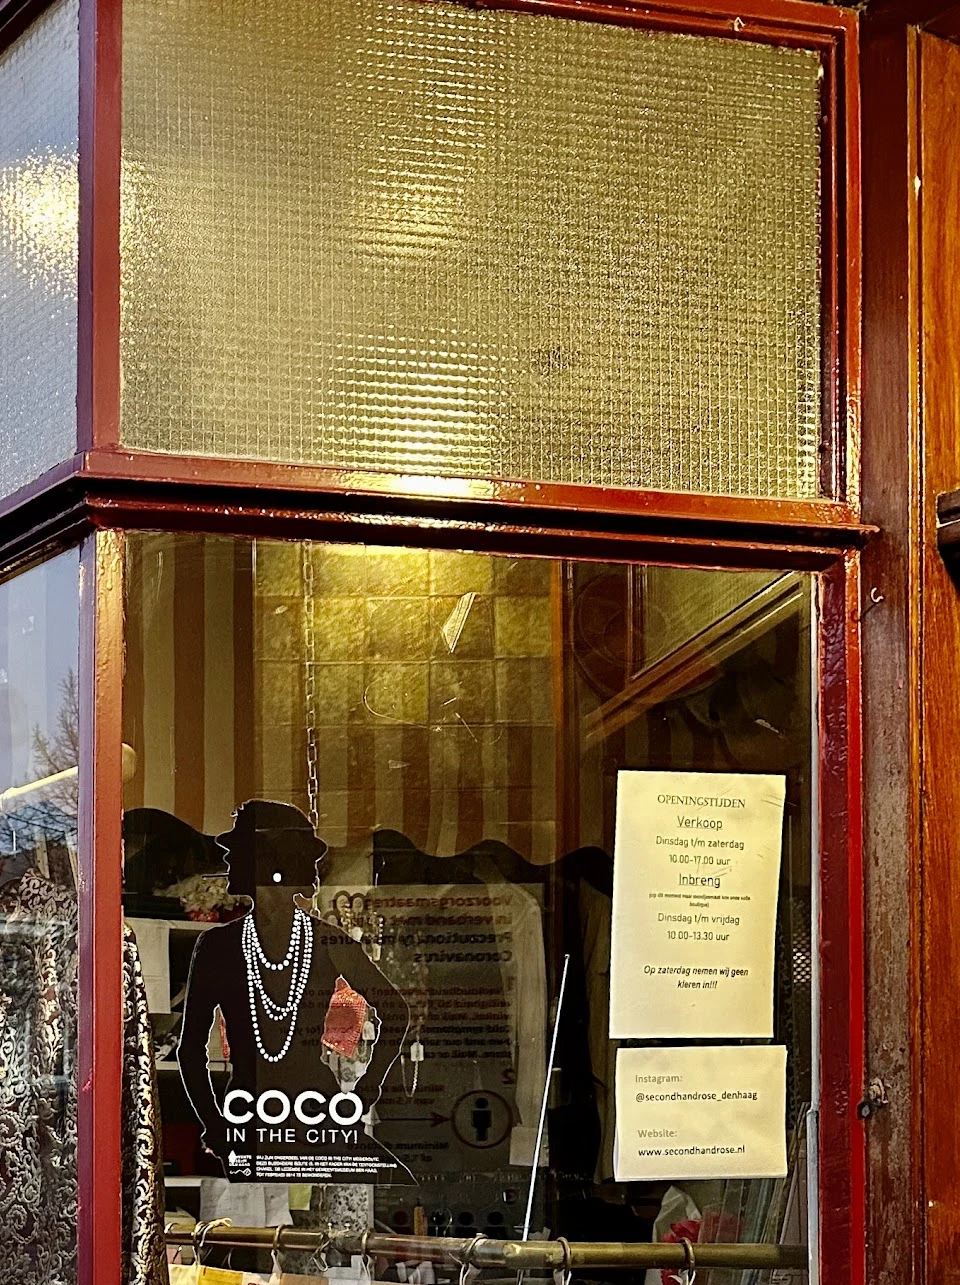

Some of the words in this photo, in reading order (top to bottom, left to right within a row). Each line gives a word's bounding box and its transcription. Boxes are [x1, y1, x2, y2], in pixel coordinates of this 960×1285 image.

[657, 793, 746, 809] OPENINGSTIJDEN
[676, 815, 723, 831] Verkoop
[656, 836, 689, 850] Dinsdag
[690, 838, 706, 850] t/m
[707, 838, 745, 852] zaterdag
[669, 854, 714, 866] 10.00-17.00
[715, 857, 732, 866] uur
[678, 873, 722, 889] Inbreng
[657, 912, 692, 925] Dinsdag
[694, 914, 709, 925] t/m
[711, 915, 740, 926] vrijdag
[667, 930, 714, 941] 10.00-13.30
[715, 933, 730, 941] uur
[643, 965, 656, 976] Op
[657, 966, 691, 977] zaterdag
[692, 968, 718, 976] nemen
[719, 967, 730, 978] wij
[730, 969, 749, 978] geen
[677, 979, 701, 989] kleren
[635, 1074, 683, 1085] Instagram:
[635, 1090, 758, 1102] @secondhandrose_denhaag
[222, 1089, 364, 1126] COCO
[226, 1128, 247, 1144] IN
[256, 1128, 297, 1144] THE
[305, 1128, 359, 1144] CITY!
[637, 1128, 678, 1138] Website:
[638, 1144, 745, 1156] www.secondhandrose.nl
